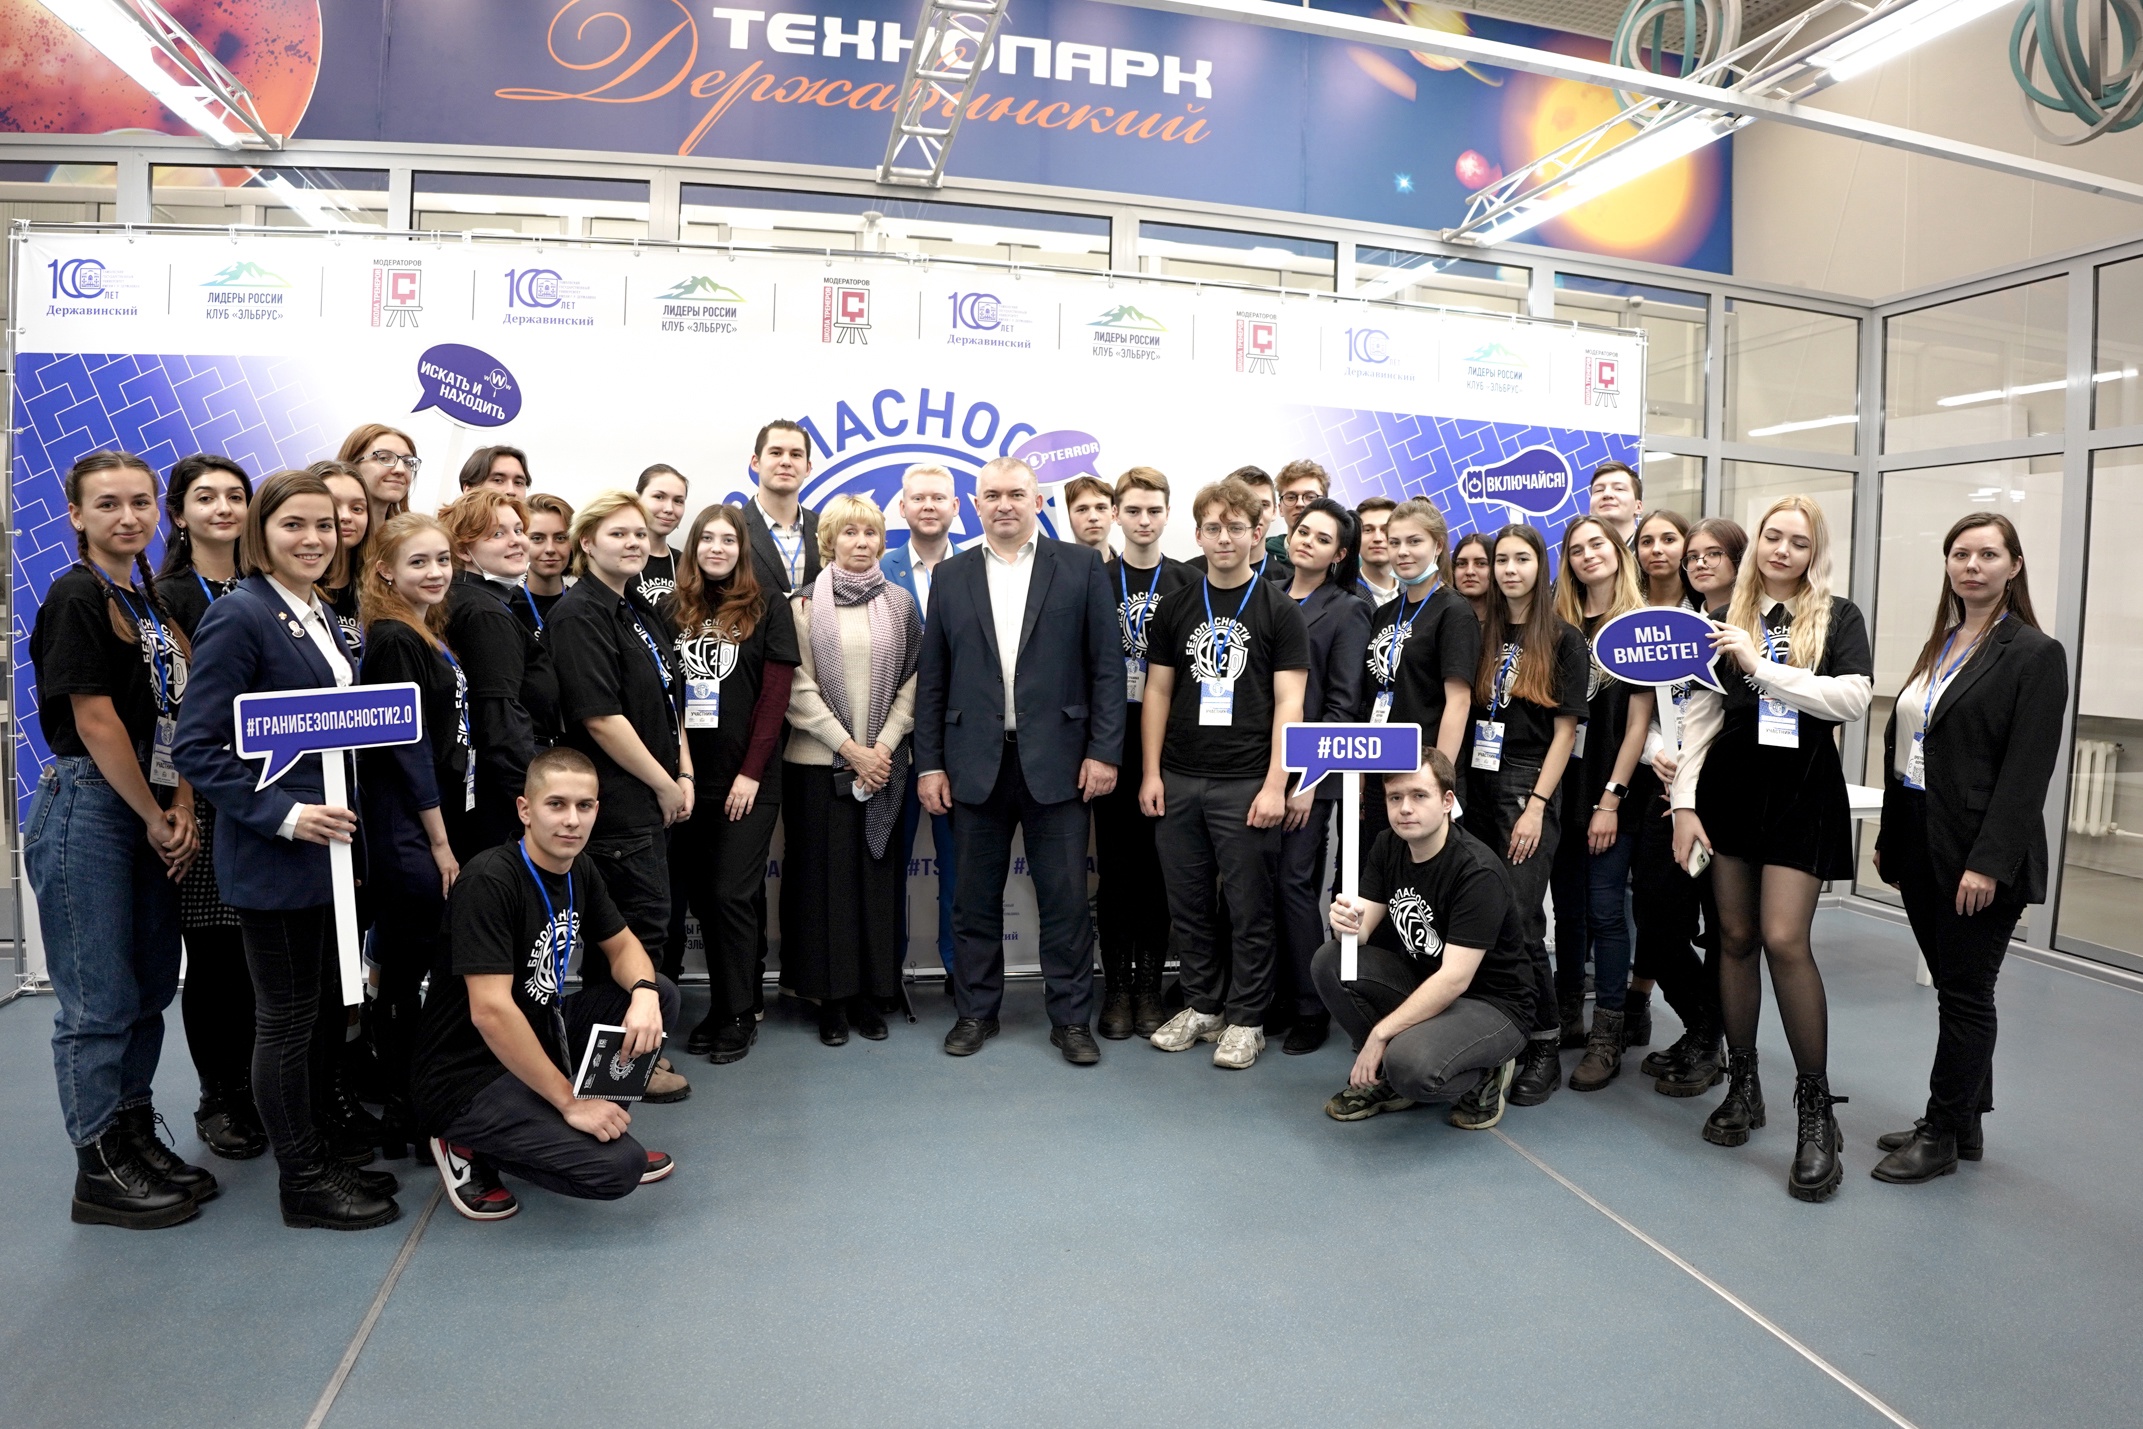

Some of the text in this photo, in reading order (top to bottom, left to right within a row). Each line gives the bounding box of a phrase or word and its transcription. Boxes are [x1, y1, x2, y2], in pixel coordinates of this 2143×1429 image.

[713, 7, 1212, 99] ТЕХНОПАРК
[823, 277, 870, 286] МОДЕРАТОРОВ
[104, 291, 119, 299] ЛЕТ
[207, 292, 283, 304] ЛИДЕРЫ РОССИИ
[46, 305, 138, 317] Державинский
[561, 301, 576, 309] ЛЕТ
[663, 305, 737, 318] ЛИДЕРЫ РОССИИ
[206, 308, 284, 320] КЛУБ «ЭЛЬБРУС»
[503, 314, 594, 326] Державинский
[1236, 311, 1277, 320] МОДЕРАТОРОВ
[661, 320, 738, 334] КЛУБ «ЭЛЬБРУС»
[1000, 324, 1014, 332] ЛЕТ
[947, 334, 1031, 348] Державинский
[1093, 331, 1160, 346] ЛИДЕРЫ РОССИИ
[1092, 346, 1114, 357] КЛУБ
[420, 360, 483, 396] ИСКАТЬ И
[1467, 366, 1523, 380] ЛИДЕРЫ РОССИИ
[439, 384, 506, 420] НАХОДИТЬ
[1486, 470, 1566, 492] ВКЛЮЧАЙСЯ!
[1634, 625, 1672, 644] МЫ
[1613, 642, 1699, 664] ВМЕСТЕ!
[1220, 653, 1240, 671] 2.0
[246, 705, 412, 737] #ГРАНИБЕЗОПАСНОСТИ2.0
[1317, 736, 1382, 759] #CISD
[524, 976, 549, 1005] РАНИ
